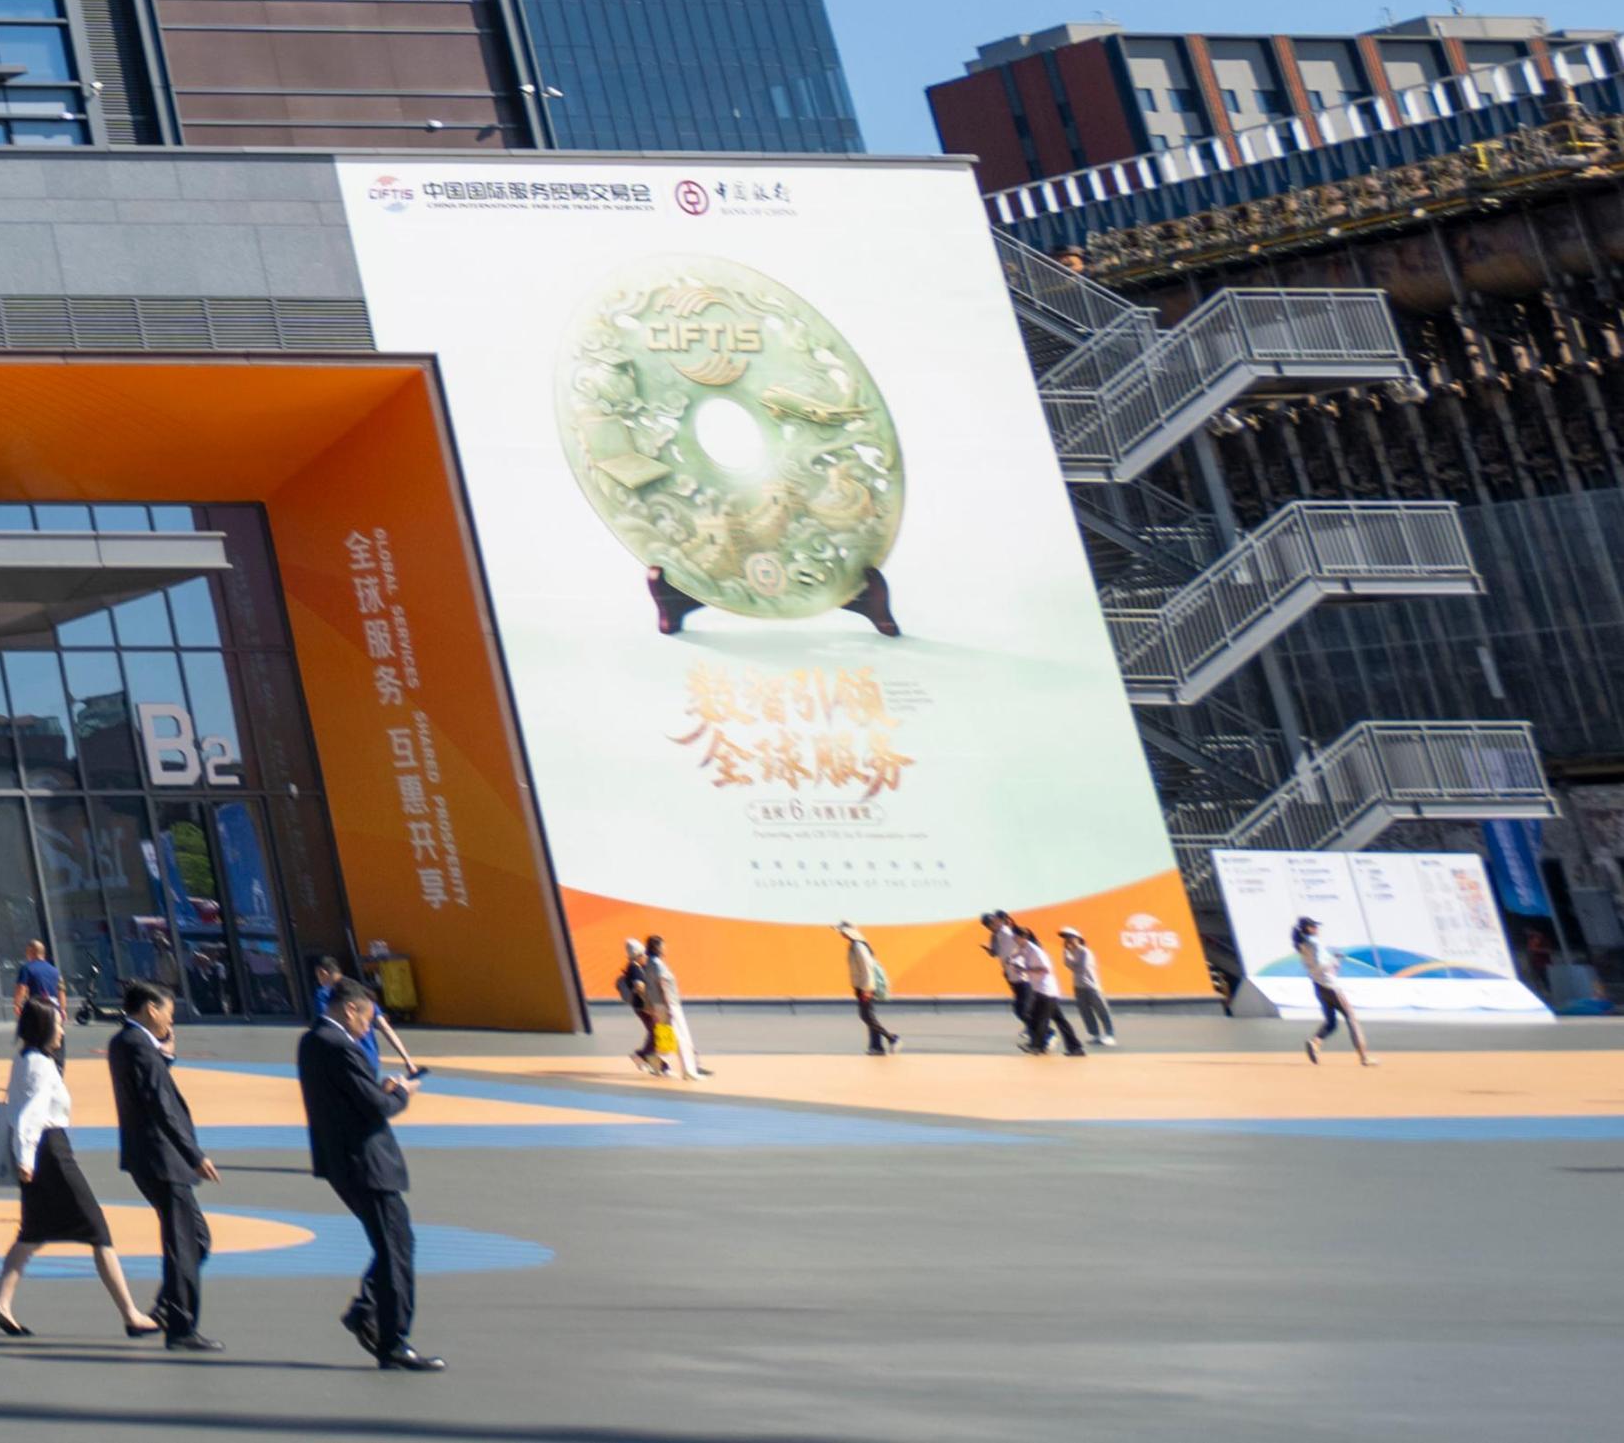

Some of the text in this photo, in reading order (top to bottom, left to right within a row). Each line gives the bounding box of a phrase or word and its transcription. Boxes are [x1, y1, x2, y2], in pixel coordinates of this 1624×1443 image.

[368, 188, 415, 201] CIFTIS
[422, 181, 653, 202] 中国国际服务贸易交易会
[647, 321, 764, 353] CIFTIS
[135, 703, 241, 787] B2
[344, 530, 449, 910] 全球服务 互惠共享
[372, 526, 470, 907] GLOBAL SERVICES SHARED PROSPERITY
[698, 727, 917, 803] 全球服务
